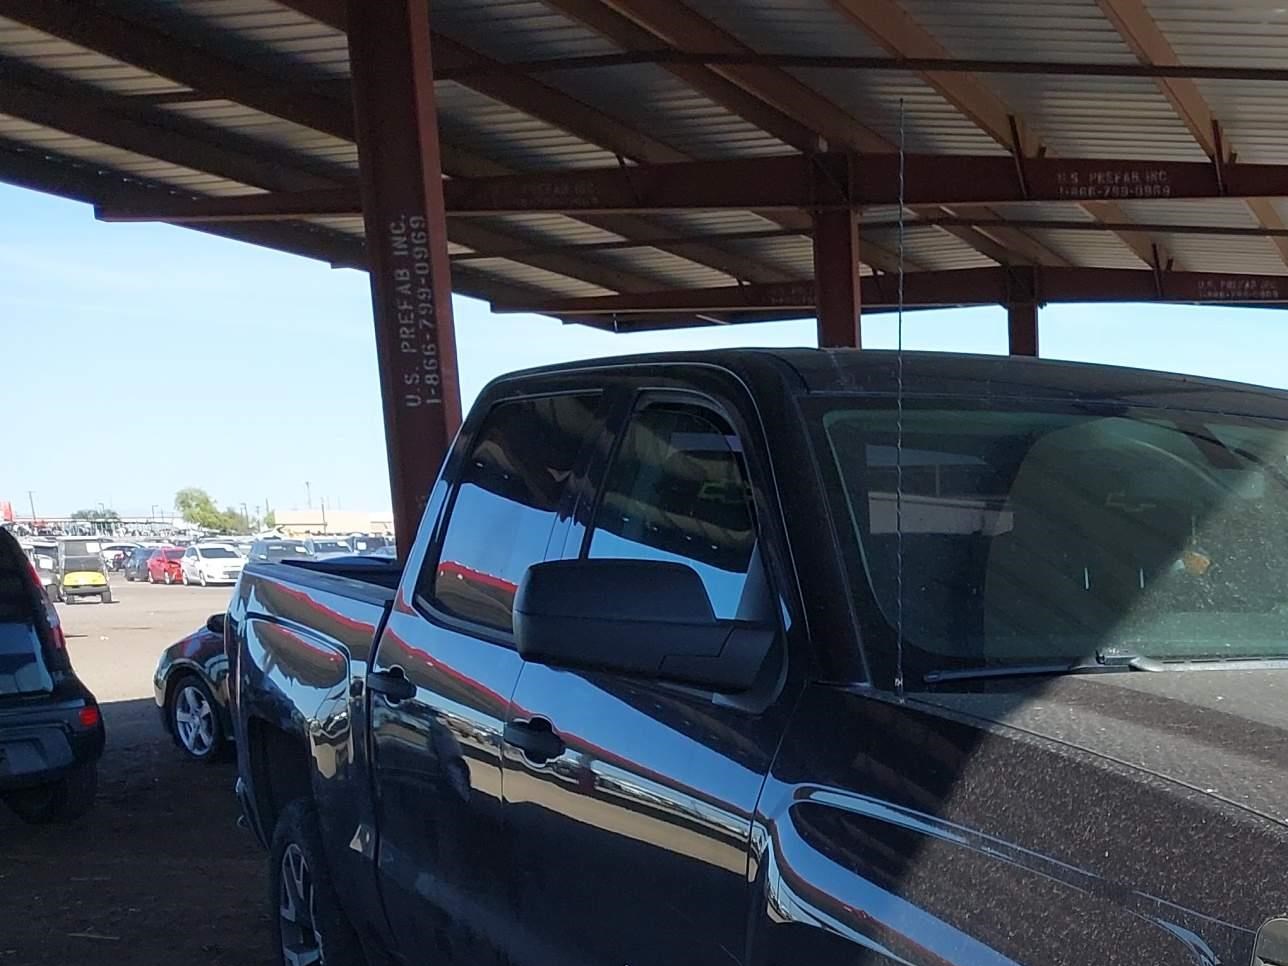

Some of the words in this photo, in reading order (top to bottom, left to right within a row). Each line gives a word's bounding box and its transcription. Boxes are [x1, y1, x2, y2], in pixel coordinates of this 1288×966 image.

[389, 214, 410, 257] INC.
[394, 269, 418, 354] PREFAB
[409, 215, 441, 405] 1-866-799-0969
[405, 367, 422, 408] U.S.
